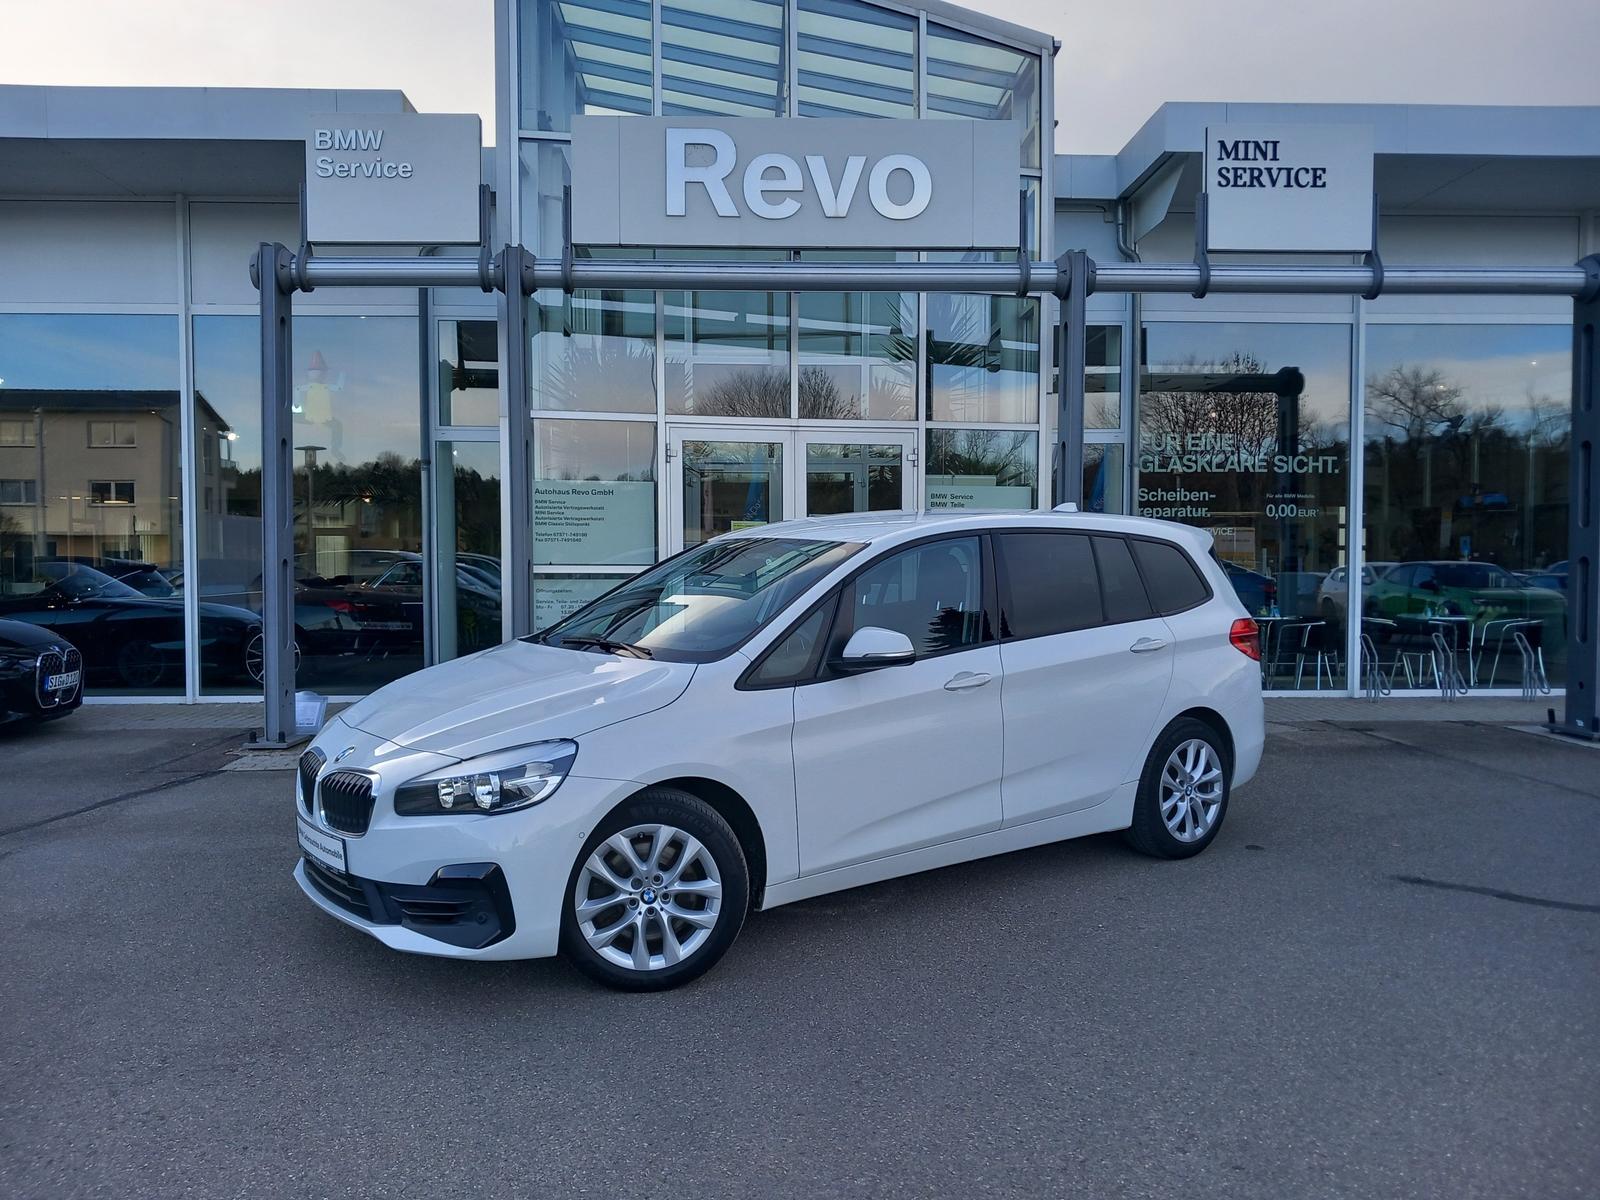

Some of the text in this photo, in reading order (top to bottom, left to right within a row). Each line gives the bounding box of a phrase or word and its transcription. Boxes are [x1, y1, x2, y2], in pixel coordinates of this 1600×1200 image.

[314, 129, 384, 151] BMW
[1217, 140, 1280, 161] MINI
[315, 156, 413, 178] Service
[665, 127, 933, 220] Revo
[1217, 167, 1327, 188] SERVICE
[1274, 455, 1340, 474] SICHT.
[534, 488, 570, 496] Autohaus
[571, 488, 590, 496] Revo
[1138, 487, 1216, 501] Scheiben-
[1138, 505, 1211, 519] reparatur.
[1266, 504, 1297, 520] 0,00
